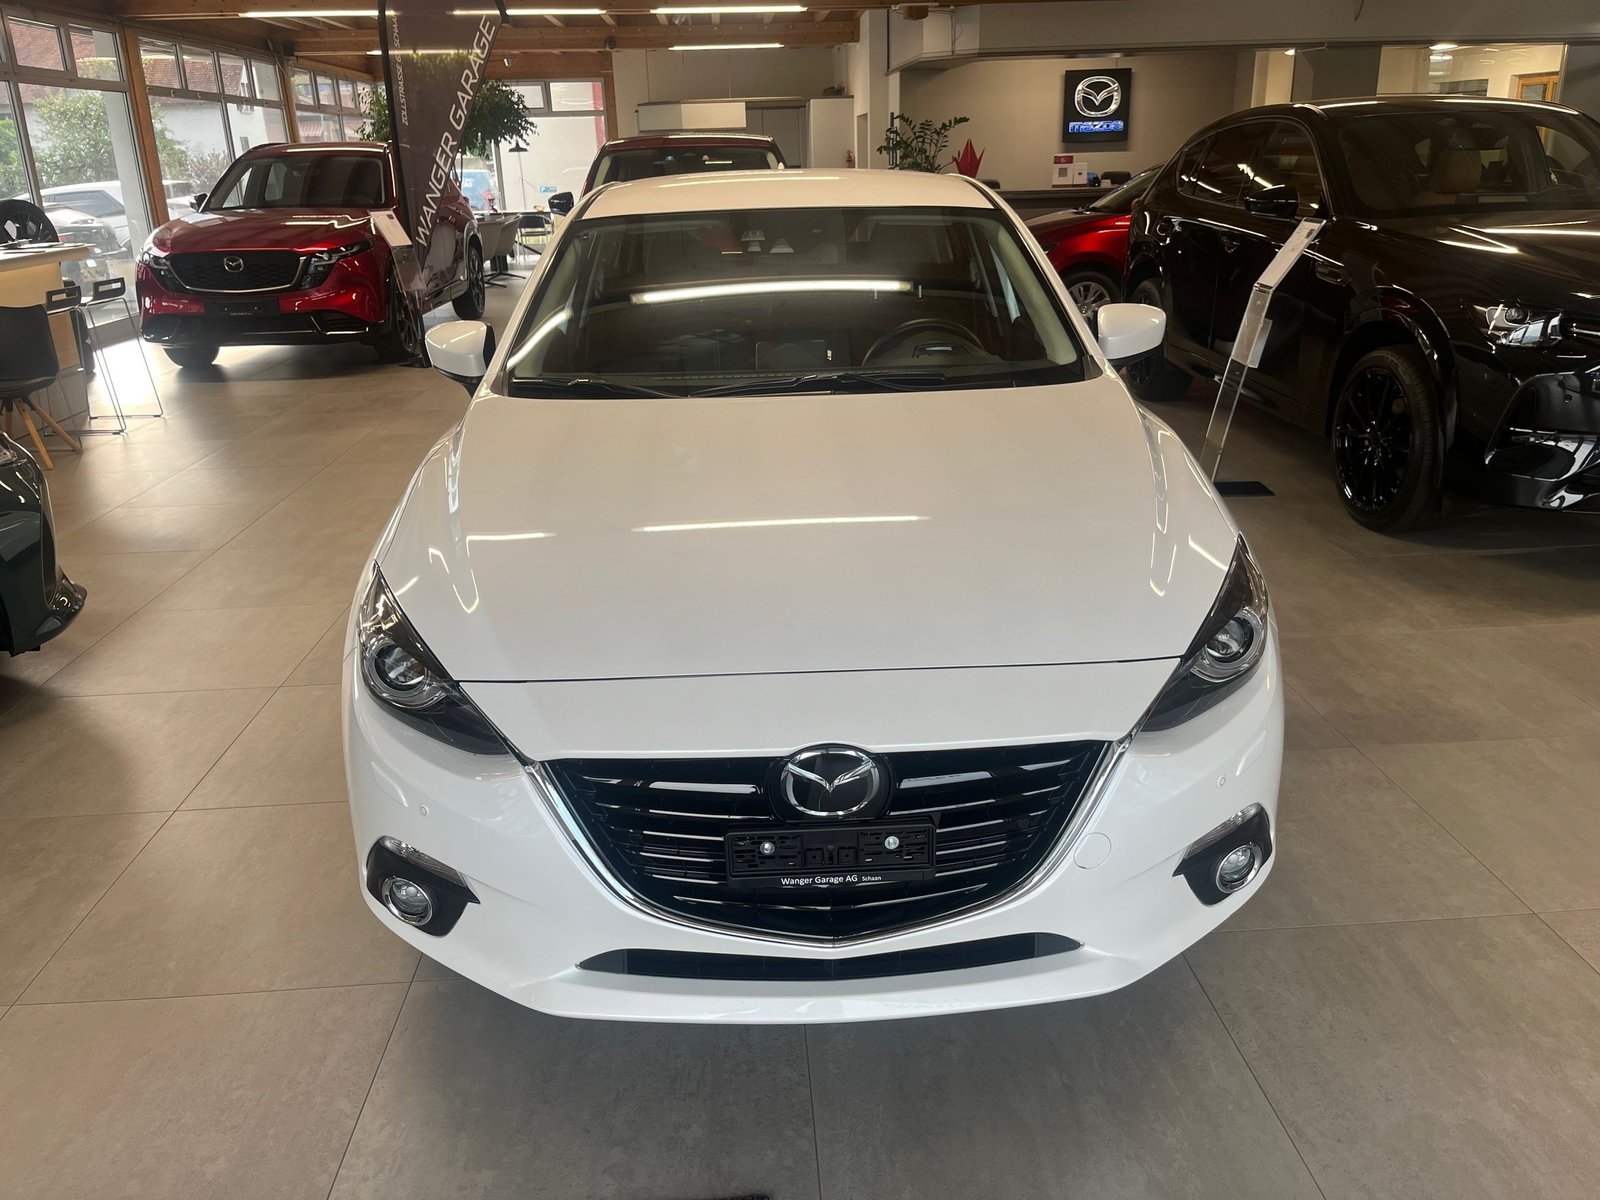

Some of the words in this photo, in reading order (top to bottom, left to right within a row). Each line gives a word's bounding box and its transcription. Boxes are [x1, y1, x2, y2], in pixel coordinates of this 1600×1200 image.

[396, 64, 409, 126] ZOLLSTRASSE
[416, 131, 457, 247] WANGER
[449, 14, 496, 131] GARAGE
[1068, 120, 1124, 133] mazda
[781, 877, 814, 886] Wanger
[815, 876, 844, 884] Garage
[845, 874, 858, 882] AG
